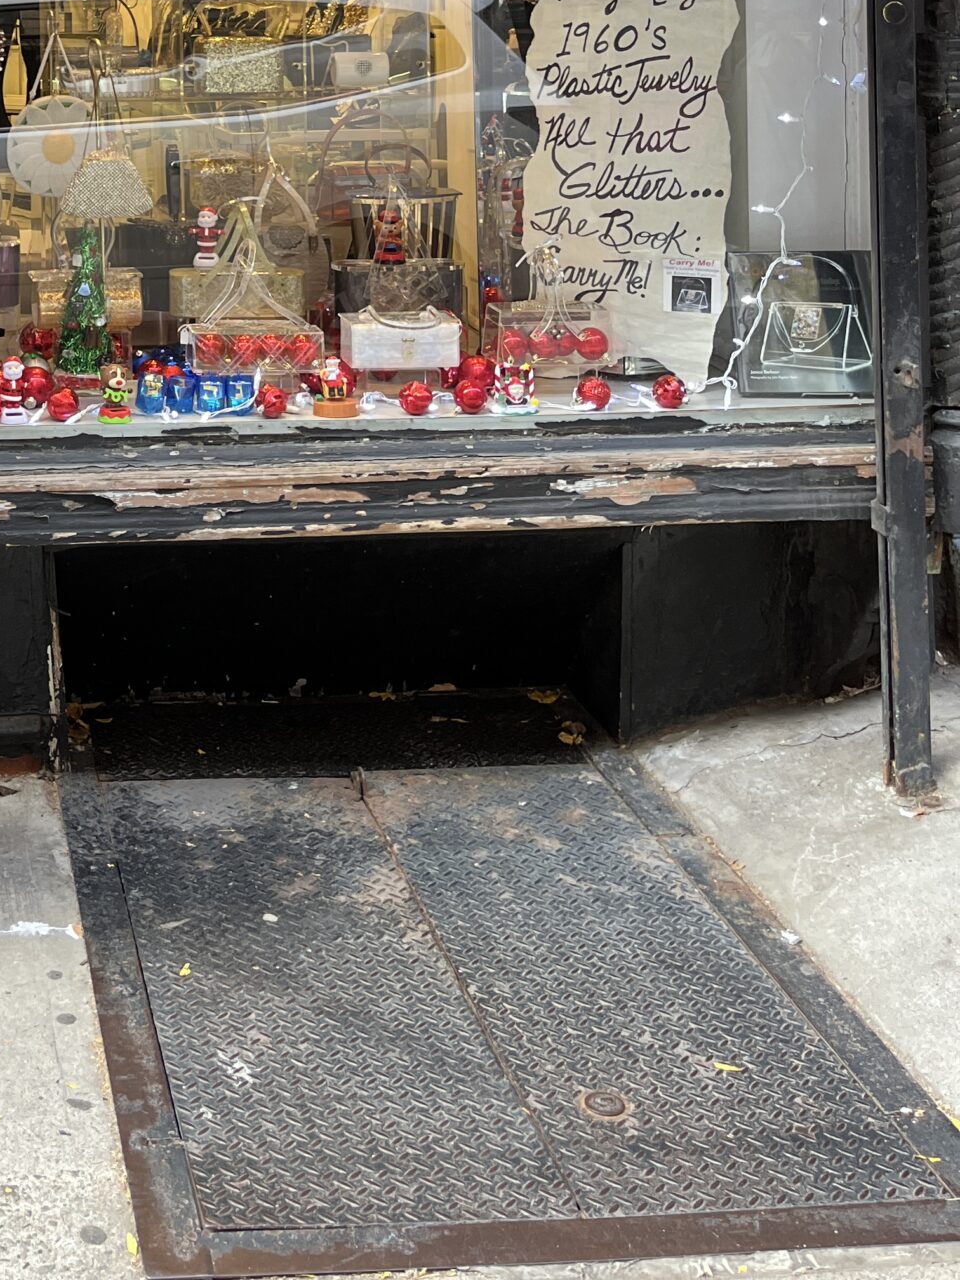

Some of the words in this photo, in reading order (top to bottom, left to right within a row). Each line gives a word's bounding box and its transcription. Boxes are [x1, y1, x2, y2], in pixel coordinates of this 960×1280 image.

[556, 18, 667, 58] 1960's
[536, 62, 627, 99] Plastic
[619, 55, 717, 119] Jewelry
[544, 112, 597, 167] All
[530, 206, 599, 238] The
[603, 259, 653, 299] Me!
[669, 259, 694, 268] Carry
